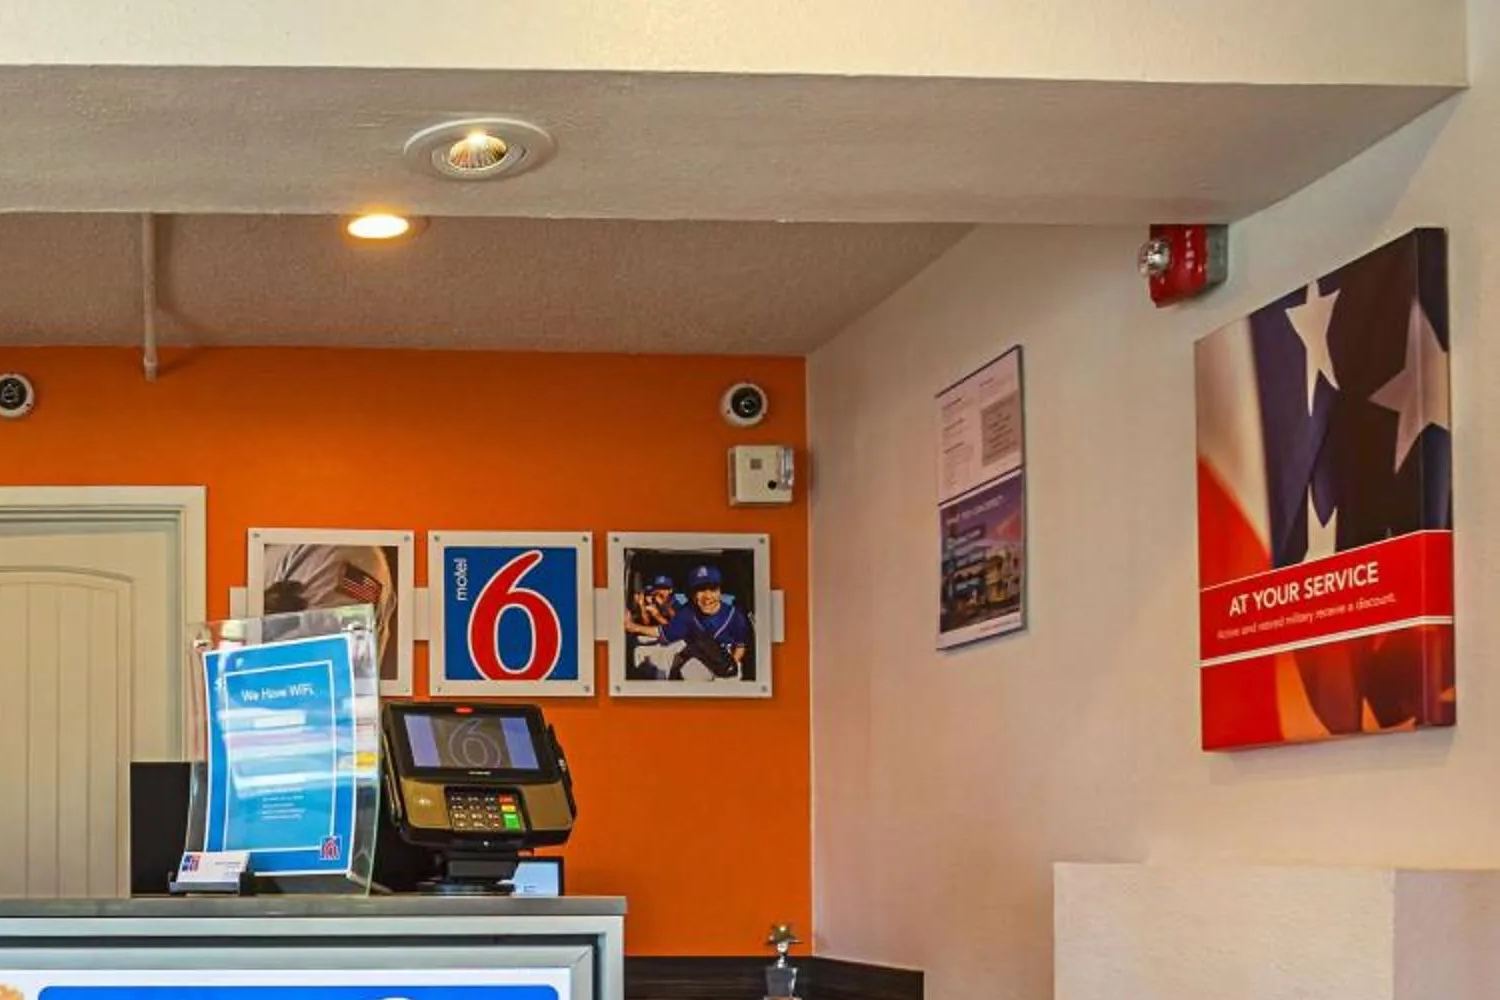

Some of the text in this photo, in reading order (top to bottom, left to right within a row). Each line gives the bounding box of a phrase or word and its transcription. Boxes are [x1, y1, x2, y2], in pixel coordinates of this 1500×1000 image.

[456, 557, 468, 602] motel
[1229, 561, 1380, 617] AT YOUR SERVICE
[467, 549, 563, 681] 6
[241, 688, 259, 702] We
